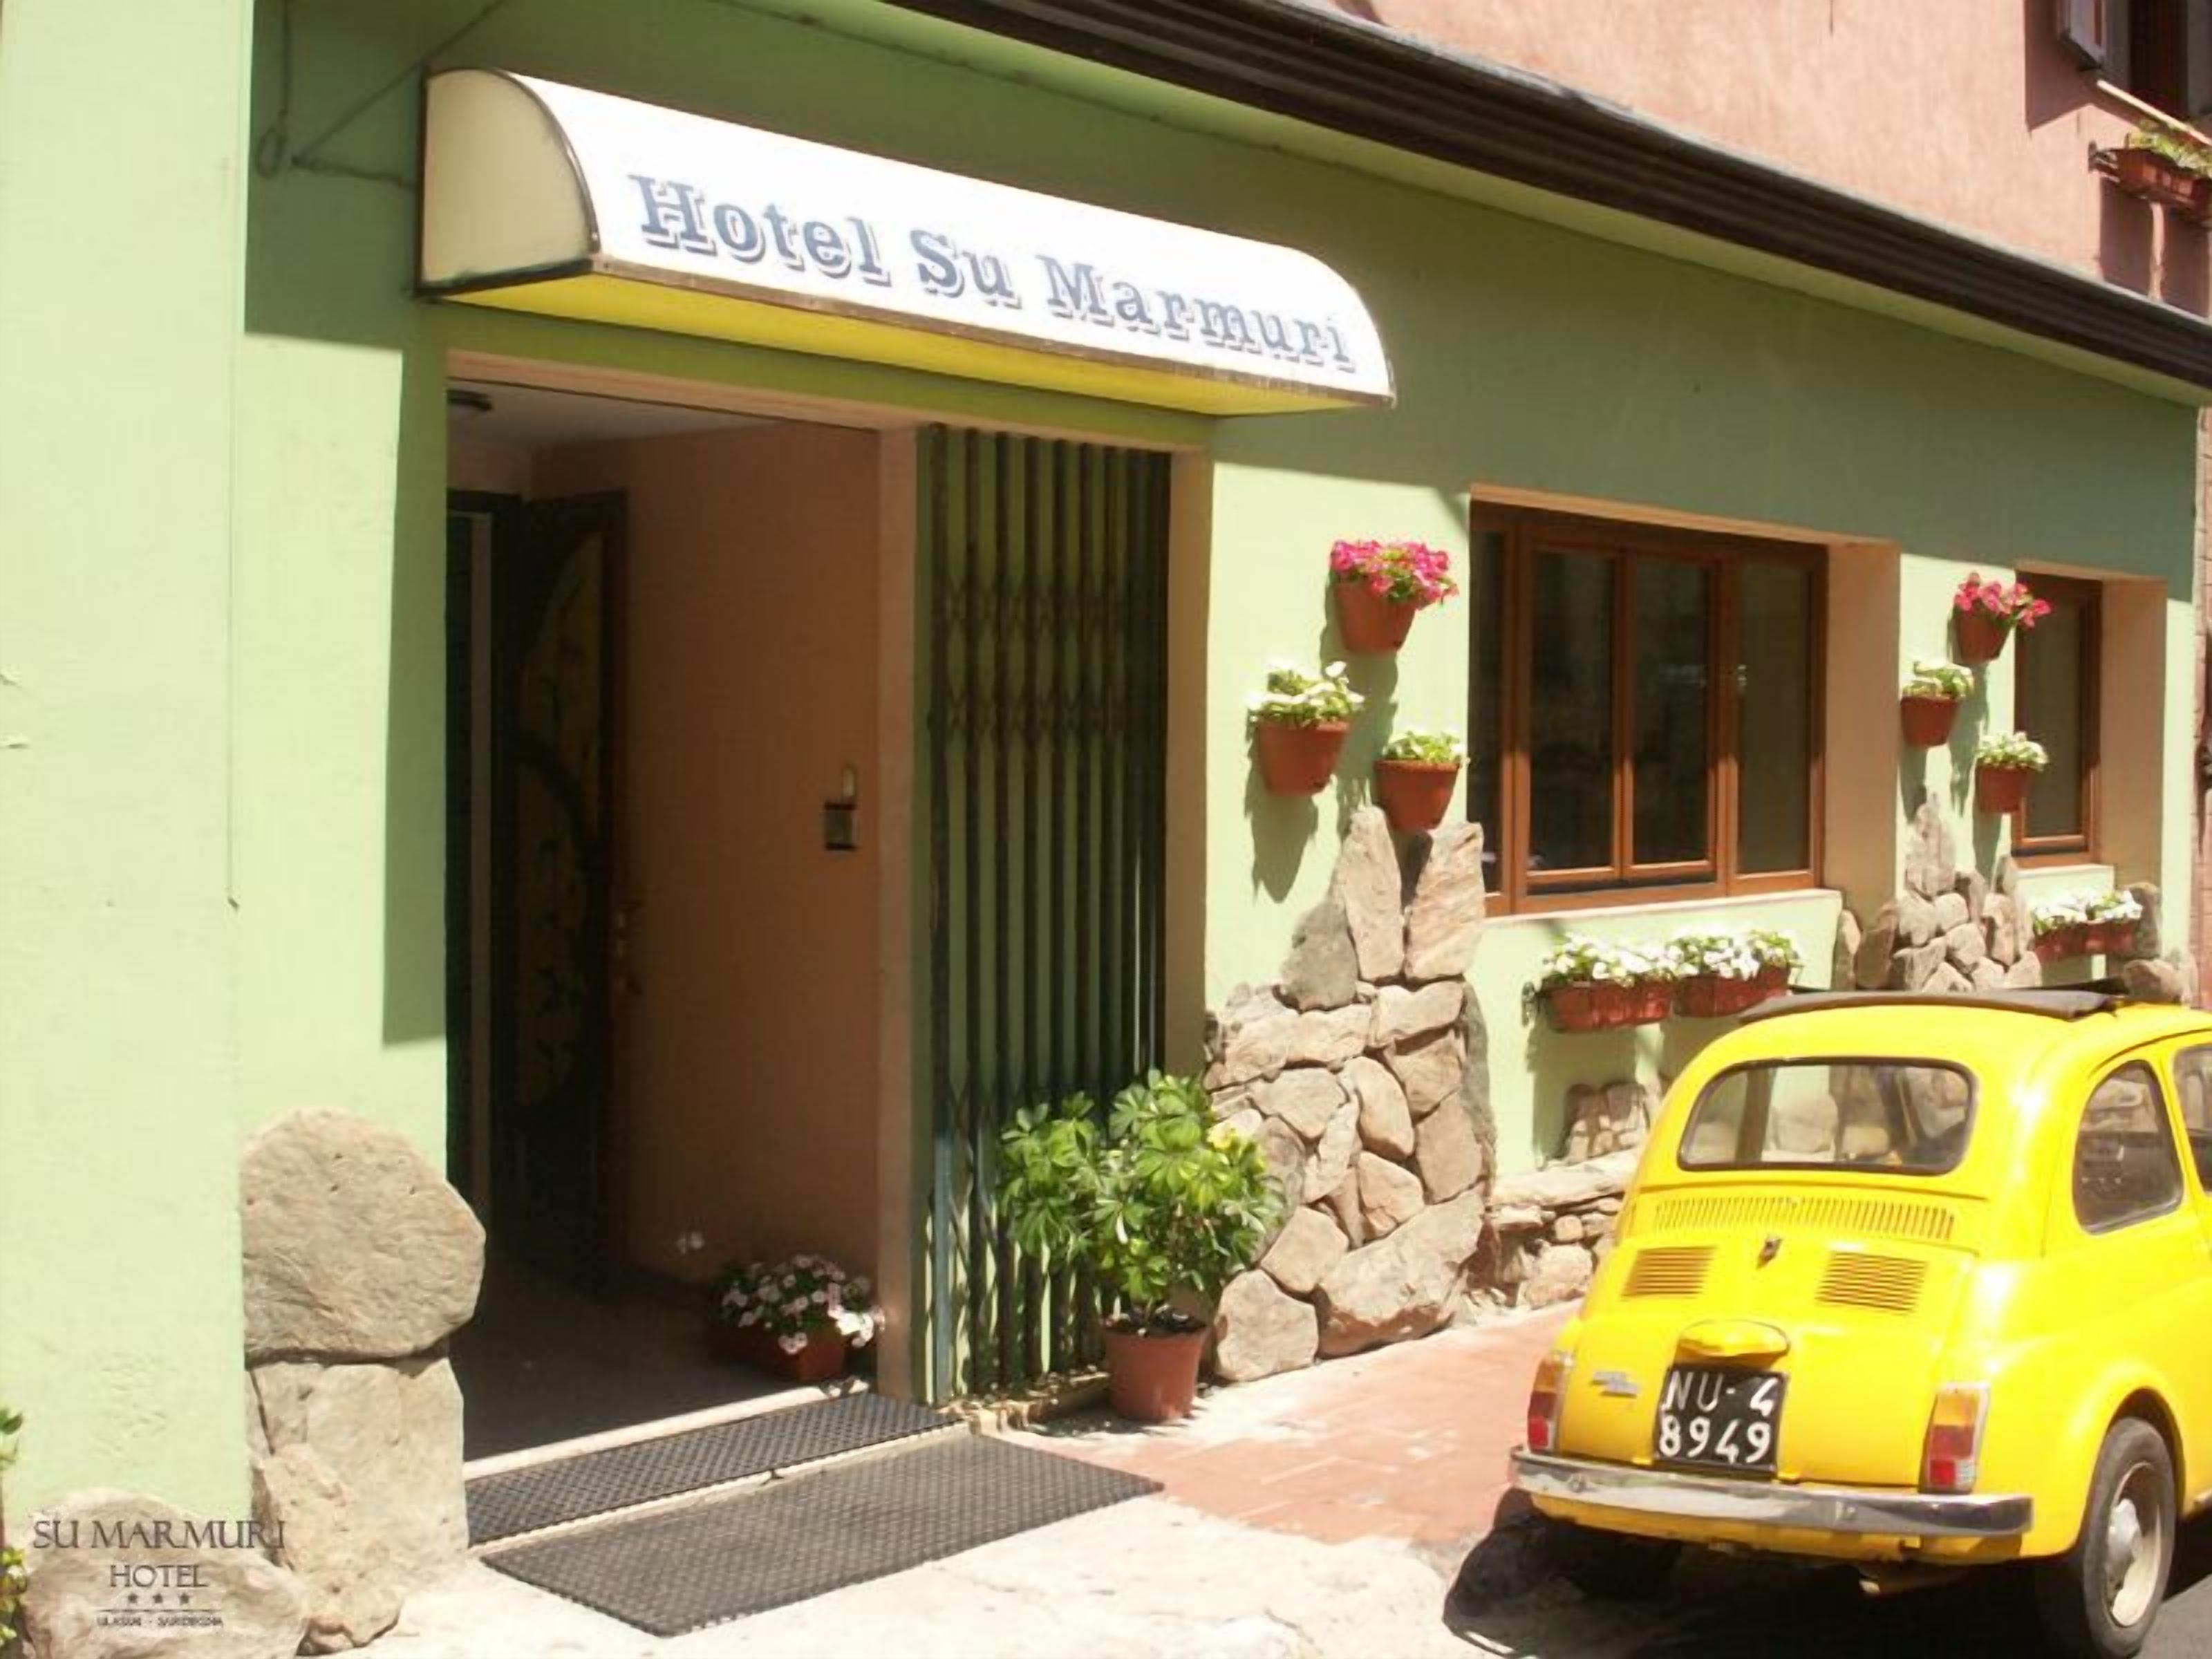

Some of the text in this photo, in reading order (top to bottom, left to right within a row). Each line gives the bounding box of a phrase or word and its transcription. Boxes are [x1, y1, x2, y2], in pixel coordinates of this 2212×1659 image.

[627, 174, 1357, 373] Hotel Su Marmuri
[1750, 1377, 1779, 1416] 4
[1659, 1416, 1771, 1463] 8949
